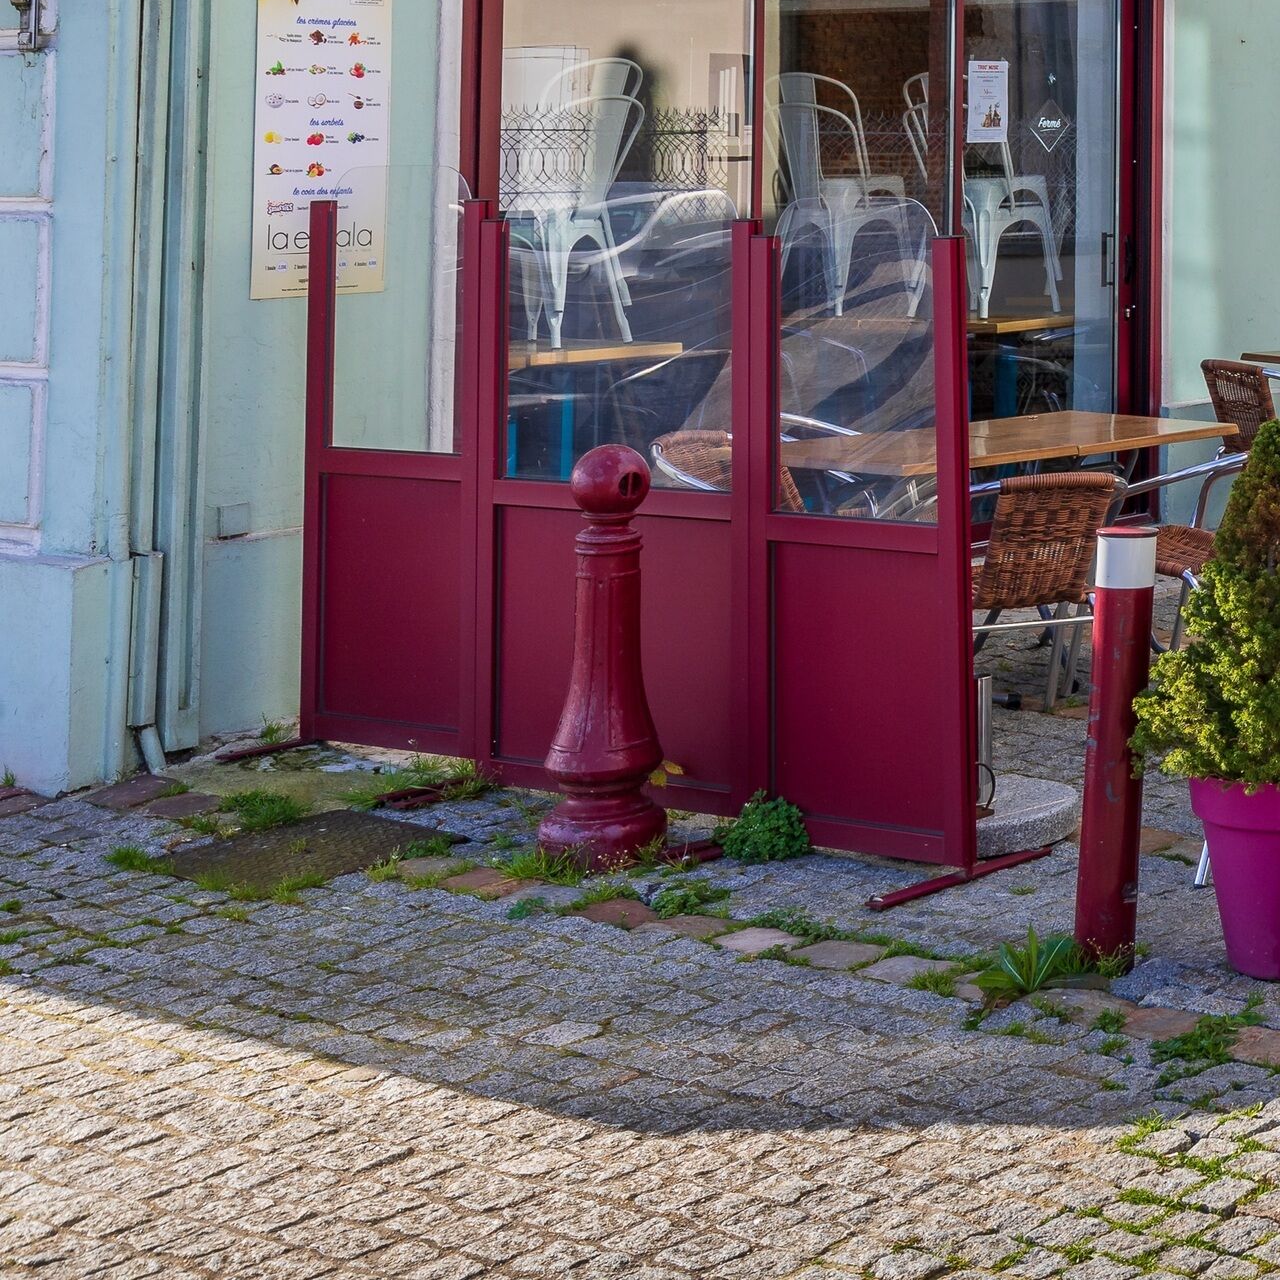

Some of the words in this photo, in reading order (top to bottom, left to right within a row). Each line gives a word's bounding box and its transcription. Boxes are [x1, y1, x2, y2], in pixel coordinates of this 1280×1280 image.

[296, 16, 306, 25] les
[309, 117, 319, 126] les
[320, 117, 344, 126] sorbets
[1037, 116, 1061, 128] Fermé
[292, 187, 300, 196] le
[316, 186, 328, 195] des
[267, 223, 289, 250] la
[293, 221, 373, 250] eala
